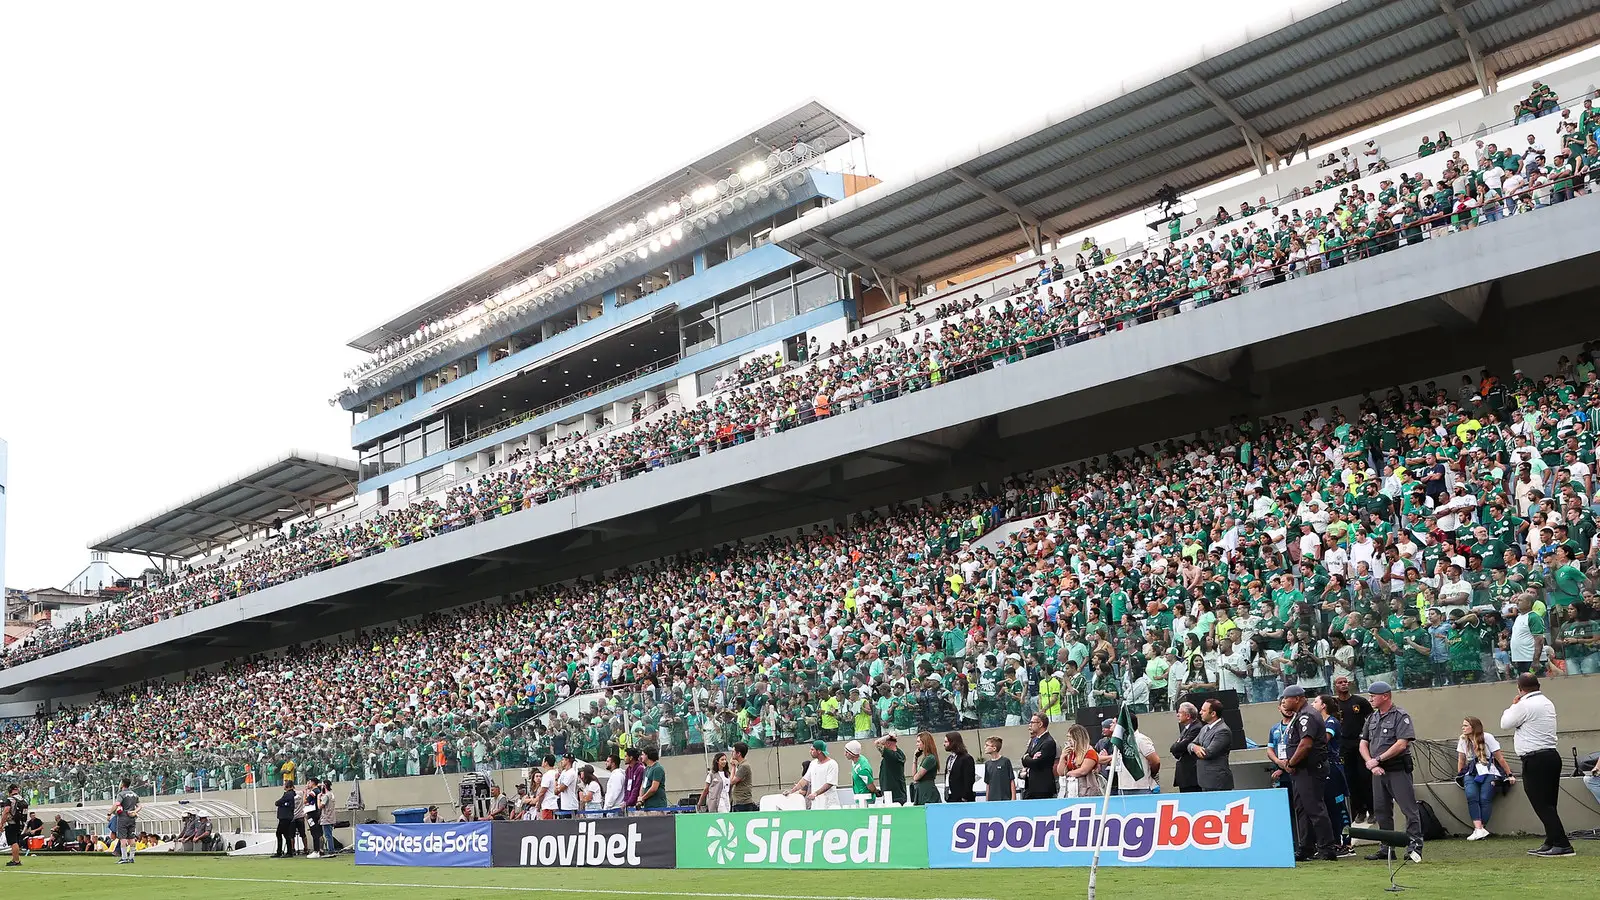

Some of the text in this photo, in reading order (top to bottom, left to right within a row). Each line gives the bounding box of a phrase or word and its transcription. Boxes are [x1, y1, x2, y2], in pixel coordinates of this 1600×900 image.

[519, 821, 642, 866] novibet
[743, 814, 892, 864] Sicredi
[953, 801, 1251, 860] sportingbet
